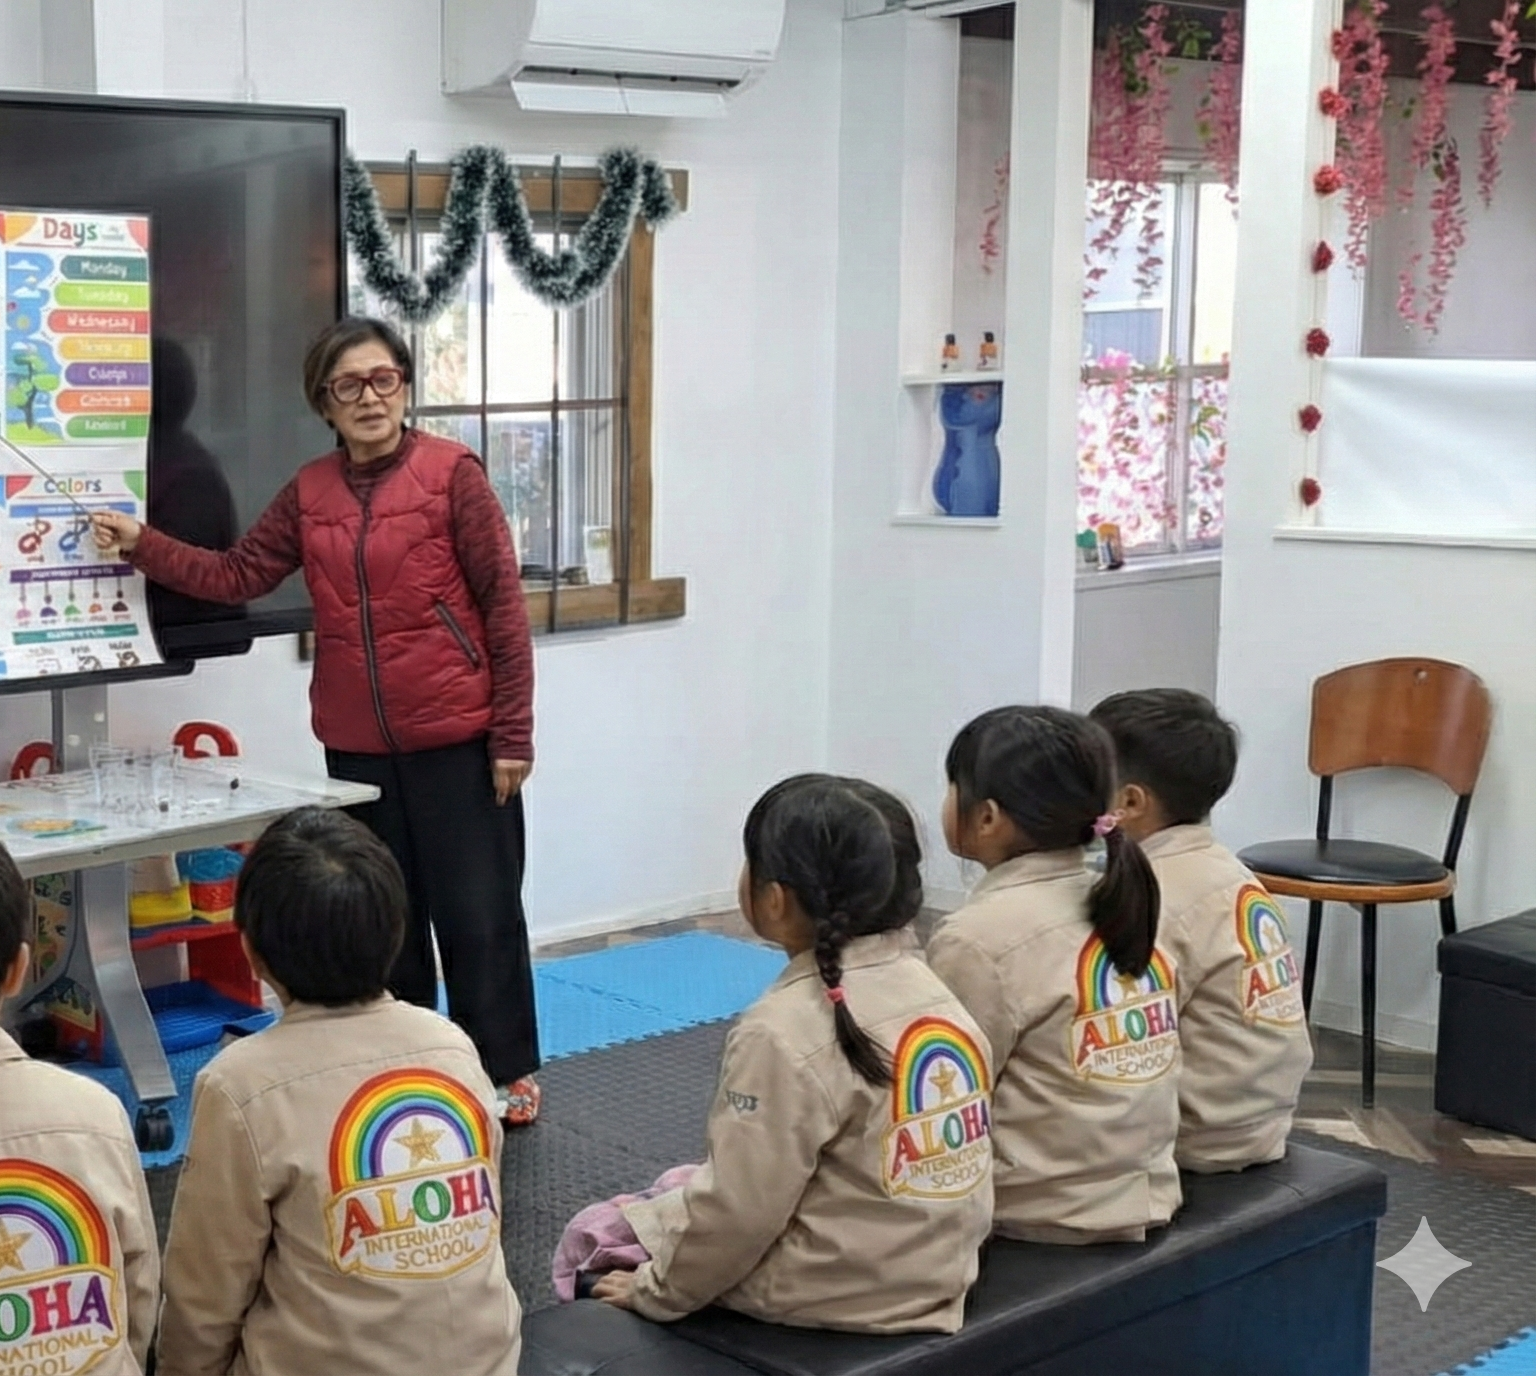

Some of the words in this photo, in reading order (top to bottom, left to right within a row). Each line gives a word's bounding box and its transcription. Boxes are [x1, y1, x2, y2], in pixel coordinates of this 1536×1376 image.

[42, 217, 98, 247] Days
[81, 261, 128, 279] Monday
[43, 477, 102, 493] Colors
[1076, 998, 1177, 1067] ALOHA
[890, 1099, 991, 1181] ALOHA
[339, 1167, 499, 1258] ALOHA
[364, 1216, 488, 1256] INTERNATIONAL
[394, 1236, 476, 1270] SCHOOL
